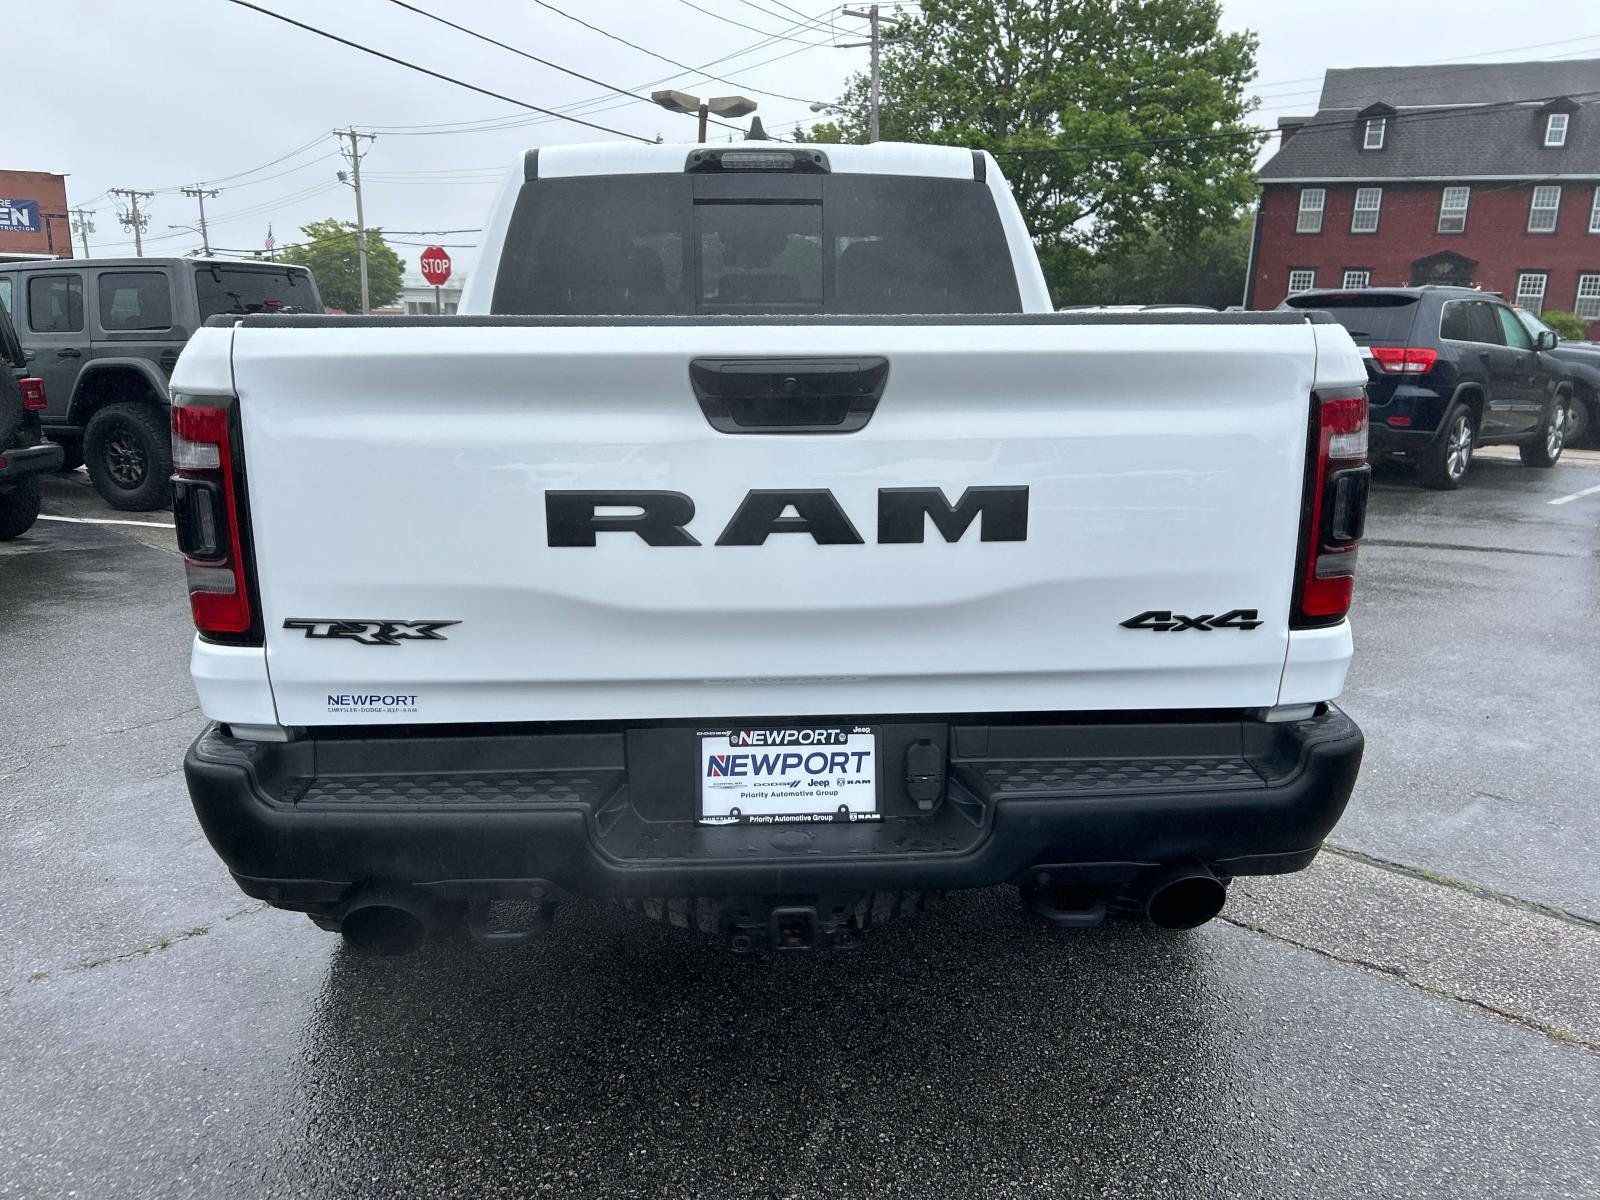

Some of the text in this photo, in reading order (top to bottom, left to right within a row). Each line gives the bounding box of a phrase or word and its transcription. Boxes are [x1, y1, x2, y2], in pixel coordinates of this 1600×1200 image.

[422, 258, 449, 274] STOP
[544, 484, 1030, 548] RAM
[1119, 608, 1264, 632] 4x4
[282, 617, 463, 646] TRX
[327, 694, 418, 706] NEWPORT
[738, 729, 840, 746] NEWPORT
[852, 726, 871, 734] Jeep
[706, 751, 871, 777] NEWPORT
[808, 779, 830, 787] Jeep
[741, 789, 839, 799] Priority Automotive Group
[749, 815, 773, 824] Priority
[774, 814, 812, 822] Automotive
[813, 813, 834, 822] Group
